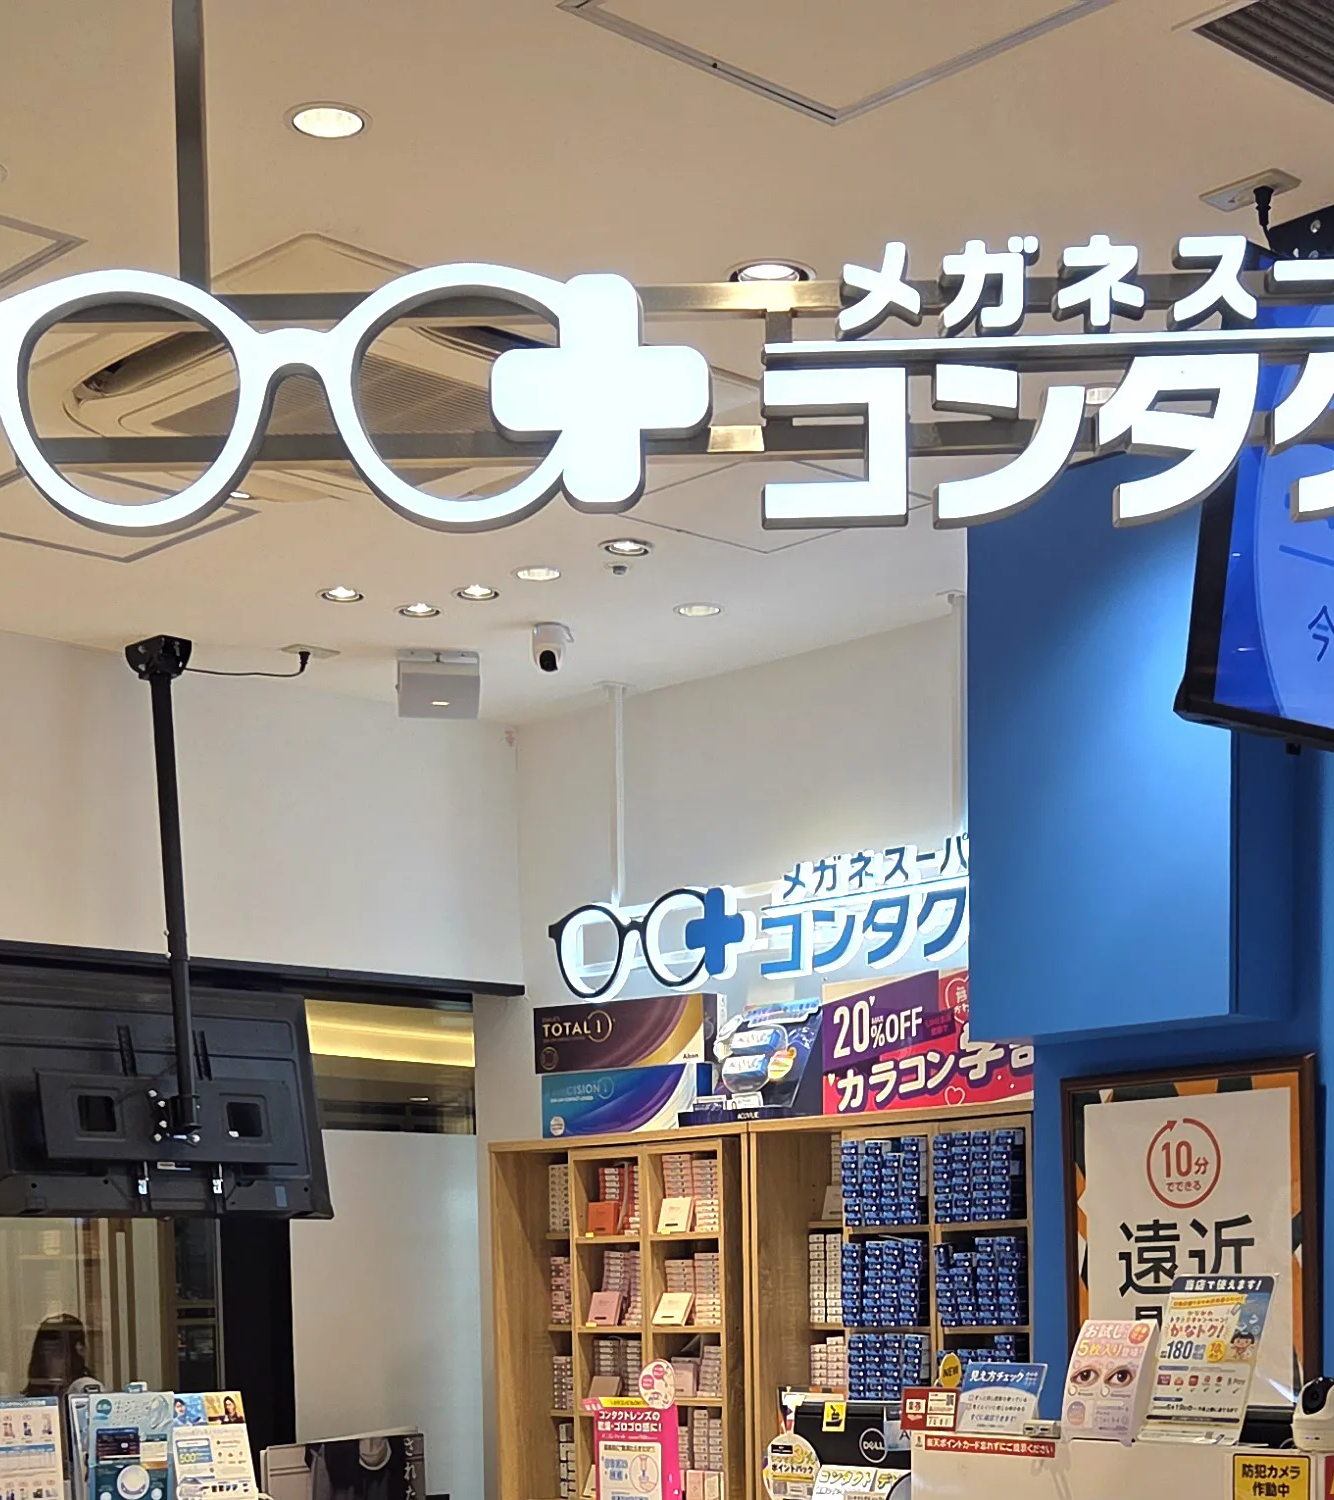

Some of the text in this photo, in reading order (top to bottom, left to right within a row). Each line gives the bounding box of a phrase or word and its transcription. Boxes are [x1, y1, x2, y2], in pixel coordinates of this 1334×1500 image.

[761, 885, 968, 973] コンタク
[833, 1000, 923, 1059] 20%OFF
[1161, 1139, 1209, 1179] 10分
[1166, 1180, 1202, 1192] でできる
[1117, 1214, 1256, 1298] 遠近
[1185, 1280, 1262, 1291] 当店で使えます!
[1167, 1340, 1194, 1360] 180
[942, 1366, 959, 1378] NEW
[970, 1369, 1024, 1383] 見え方チェック
[598, 1411, 661, 1422] コンタクトレンズの
[1241, 1463, 1301, 1481] 防犯カメラ
[1252, 1481, 1290, 1498] 作動中
